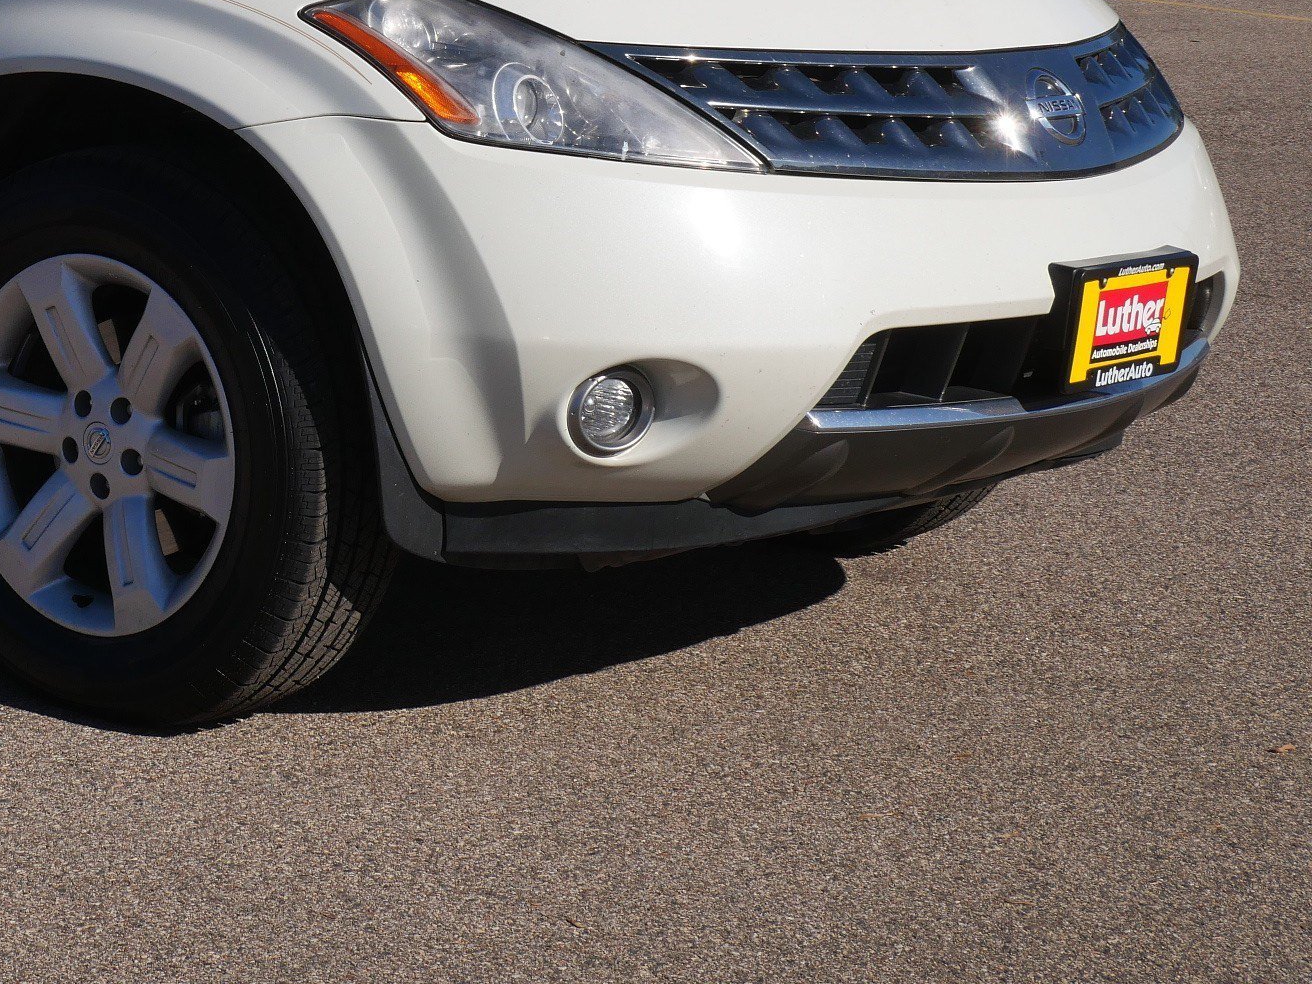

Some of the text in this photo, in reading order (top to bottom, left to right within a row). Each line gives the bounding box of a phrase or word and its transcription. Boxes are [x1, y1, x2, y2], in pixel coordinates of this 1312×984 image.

[1118, 263, 1165, 276] LutherAuto.com
[1095, 294, 1165, 337] Luther
[1091, 338, 1158, 359] Automobile Dealerships
[1095, 361, 1154, 387] LutherAuto
